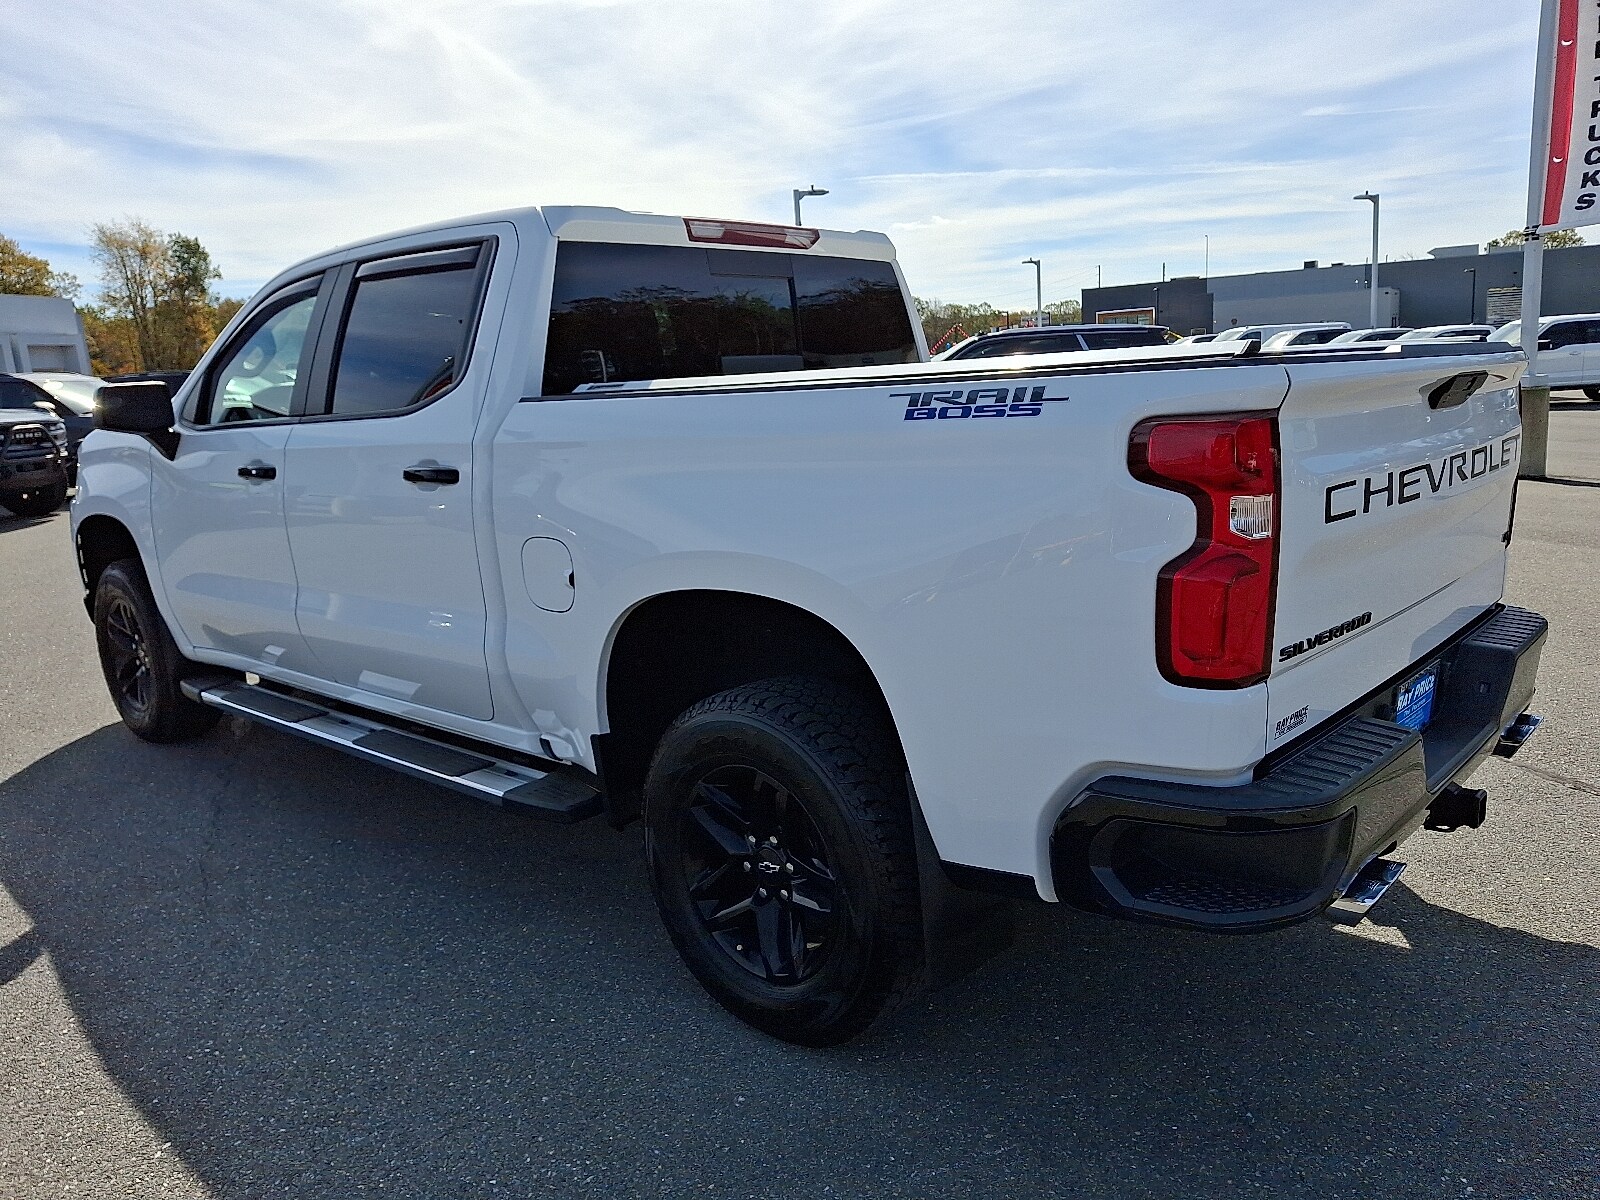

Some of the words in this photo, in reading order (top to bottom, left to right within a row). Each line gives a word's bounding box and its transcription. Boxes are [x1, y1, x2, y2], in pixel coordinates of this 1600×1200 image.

[889, 386, 1070, 408] TRAIL
[904, 402, 1043, 421] BOSS
[1324, 433, 1521, 524] CHEVROLET
[1278, 611, 1373, 663] SILVERADO
[1396, 687, 1415, 712] RAY
[1413, 674, 1436, 701] PRICE
[1275, 715, 1290, 732] RAY
[1288, 704, 1310, 725] PRICE
